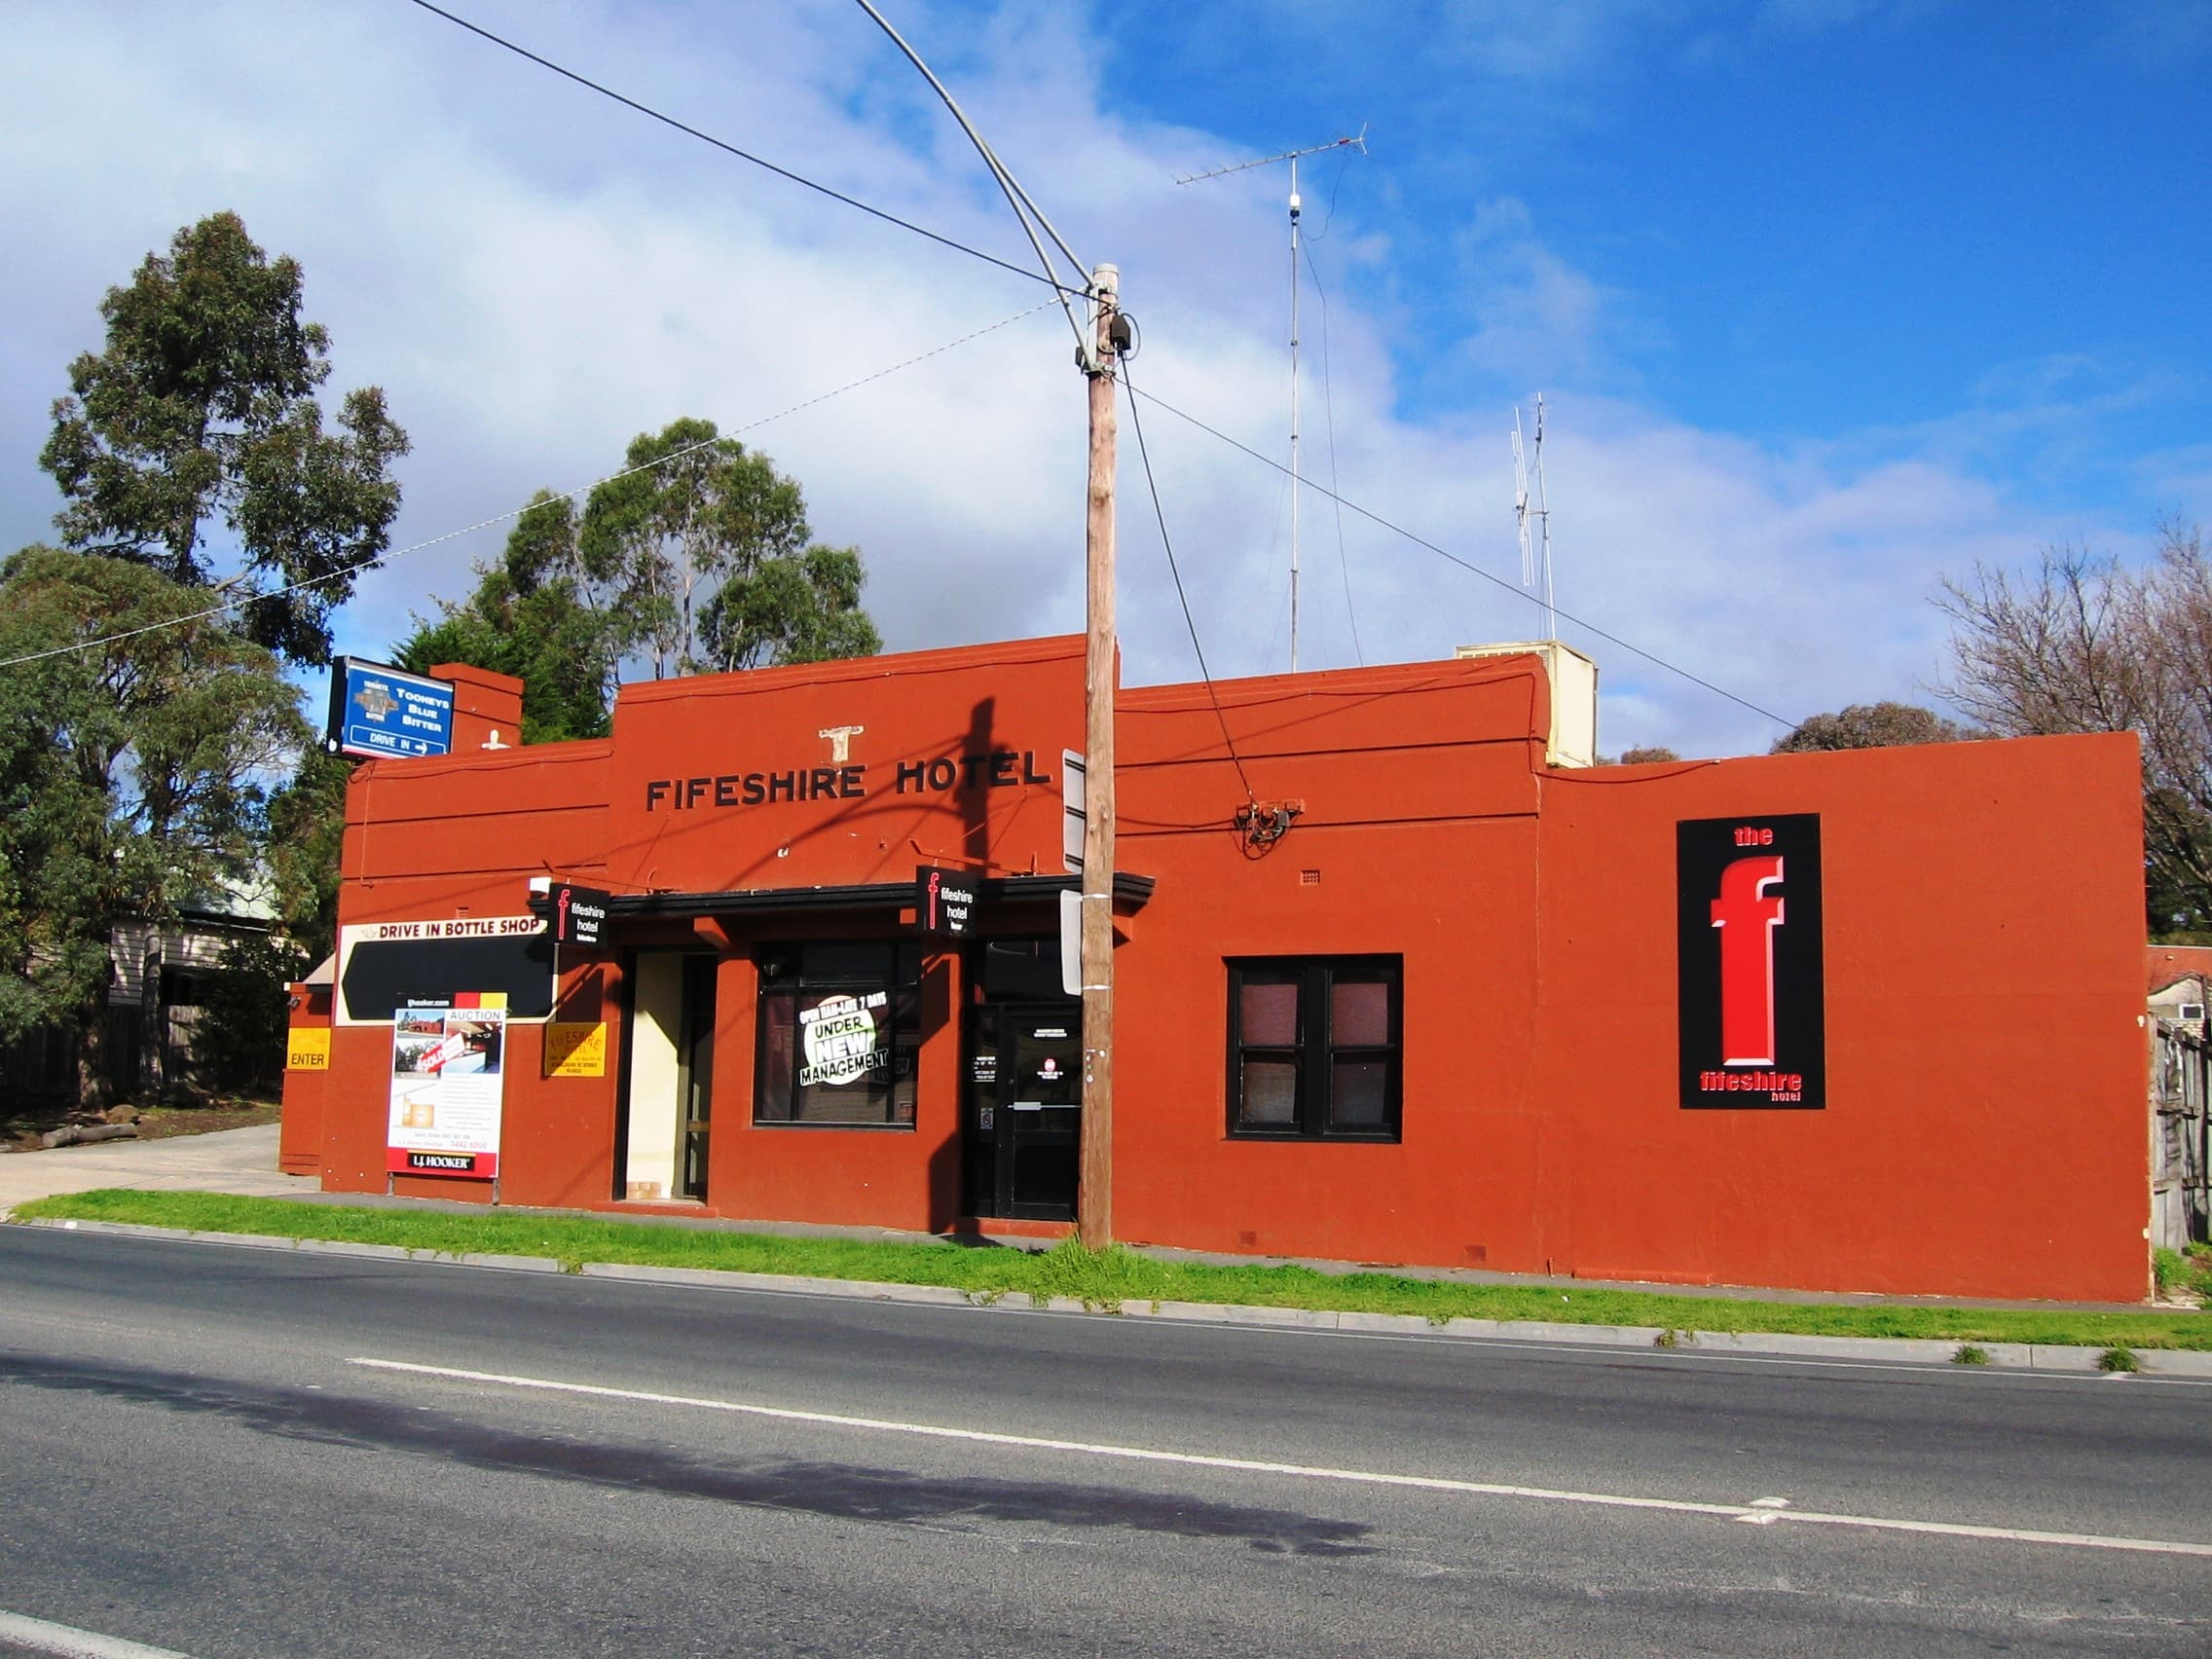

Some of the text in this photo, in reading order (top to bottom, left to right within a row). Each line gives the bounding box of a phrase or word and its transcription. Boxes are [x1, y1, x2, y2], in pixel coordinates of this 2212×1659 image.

[395, 687, 450, 709] TOOHEYS
[369, 732, 410, 750] DRIVE IN
[646, 750, 1052, 812] FIFESHIRE HOTEL
[1733, 826, 1773, 846] the
[940, 886, 974, 903] fifeshire
[571, 902, 606, 919] fifeshire
[946, 904, 968, 920] hotel
[380, 918, 539, 938] DRIVE IN BOTTLE SHOP
[576, 918, 599, 933] hotel
[1710, 855, 1785, 1066] f
[450, 1011, 500, 1020] AUCTION
[815, 1016, 864, 1038] UNDER
[816, 1029, 868, 1064] NEW
[291, 1052, 324, 1065] ENTER
[422, 1052, 446, 1070] SOLD
[800, 1049, 889, 1085] MANAGEMENT
[1699, 1070, 1802, 1091] fifeshire
[1771, 1091, 1801, 1101] hotel
[425, 1156, 468, 1169] HOOKER
